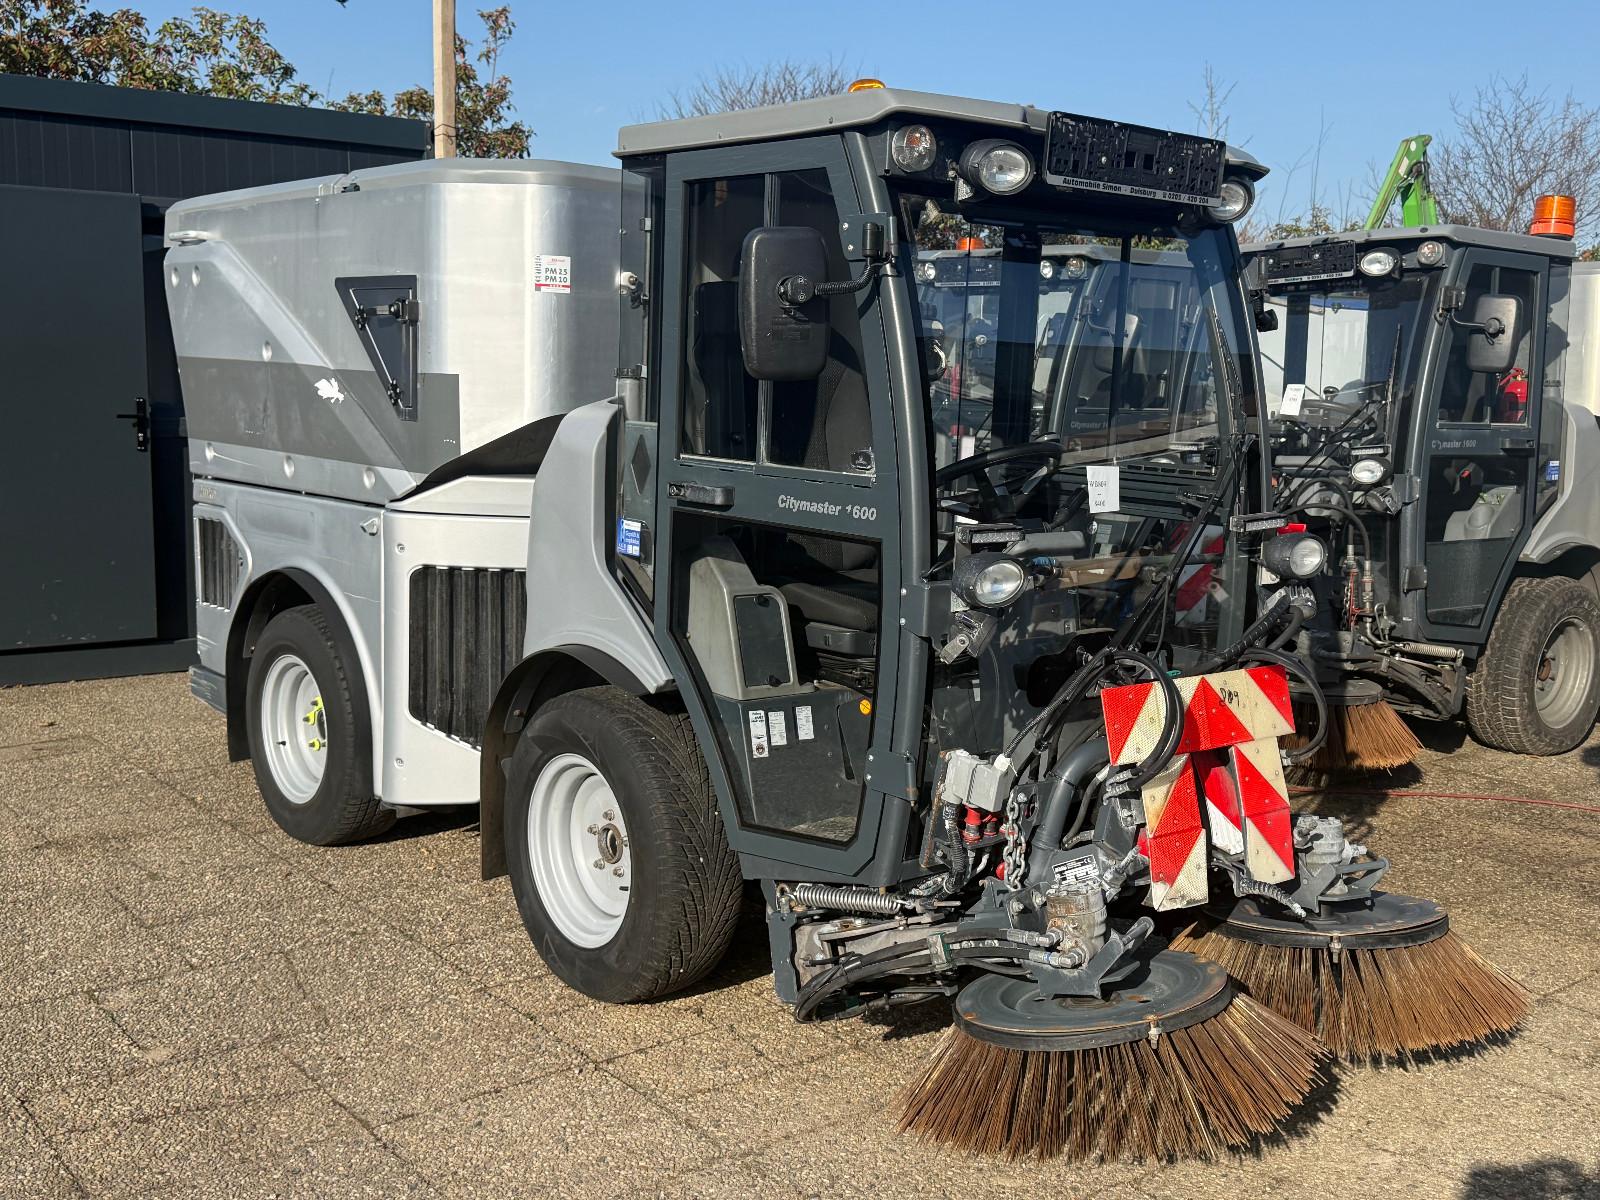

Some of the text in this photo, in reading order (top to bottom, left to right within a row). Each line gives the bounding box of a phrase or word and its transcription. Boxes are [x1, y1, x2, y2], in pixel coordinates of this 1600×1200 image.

[1062, 177, 1101, 190] Automobile
[1101, 182, 1122, 193] Simon
[544, 266, 558, 275] PM
[544, 274, 558, 283] PM
[777, 494, 877, 521] Citymaster 1600
